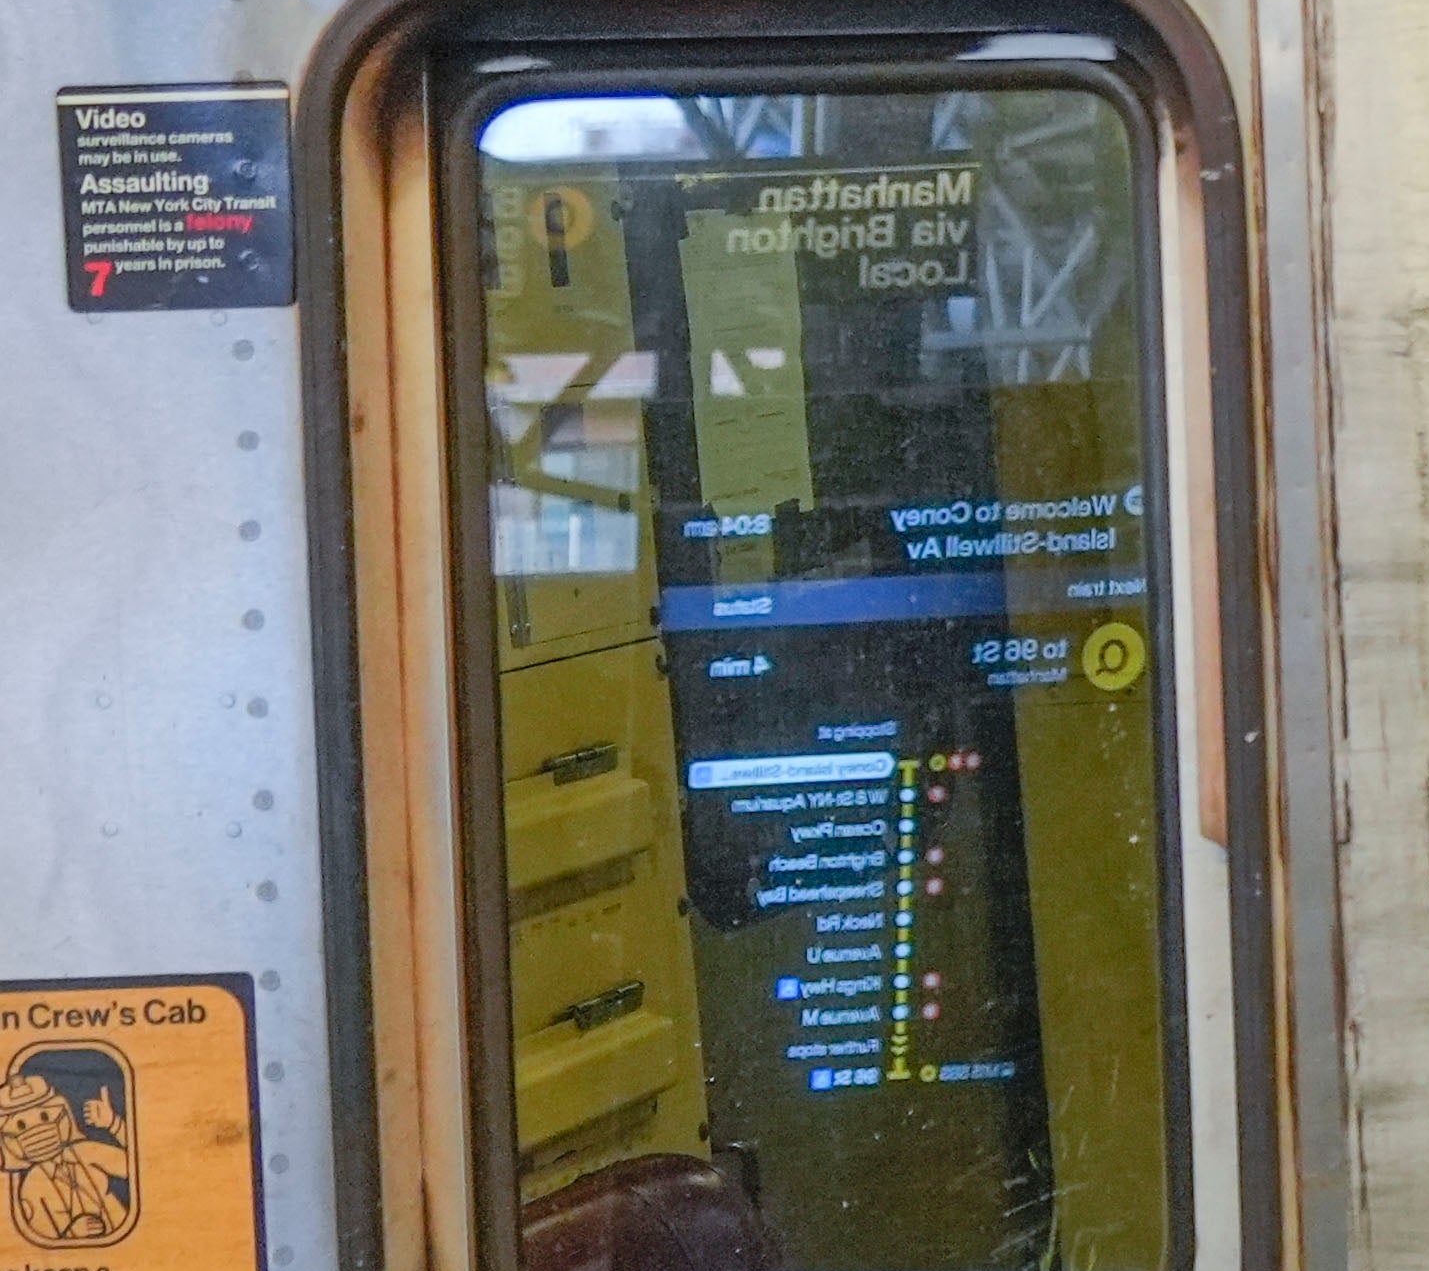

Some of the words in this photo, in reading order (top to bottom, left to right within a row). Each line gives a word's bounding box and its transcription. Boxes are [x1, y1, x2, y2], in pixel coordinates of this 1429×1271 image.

[75, 109, 146, 130] Video
[77, 134, 166, 148] surveillance
[169, 132, 233, 145] cameras
[78, 152, 109, 166] may
[112, 151, 132, 164] be
[133, 151, 148, 163] in
[150, 151, 182, 163] use.
[80, 171, 210, 195] Assaulting
[81, 201, 117, 214] MTA
[118, 200, 151, 213] New
[153, 199, 190, 212] York
[192, 198, 222, 213] City
[224, 196, 276, 210] Transit
[82, 220, 157, 237] personnel
[159, 219, 171, 232] is
[173, 221, 183, 232] a
[84, 238, 164, 256] punishable
[167, 238, 185, 253] by
[187, 238, 206, 252] up
[208, 237, 225, 250] to
[84, 260, 113, 297] 7
[114, 259, 156, 274] years
[158, 258, 171, 270] in
[174, 257, 226, 272] prison.
[28, 1000, 136, 1029] Crew's
[144, 998, 206, 1025] Cab
